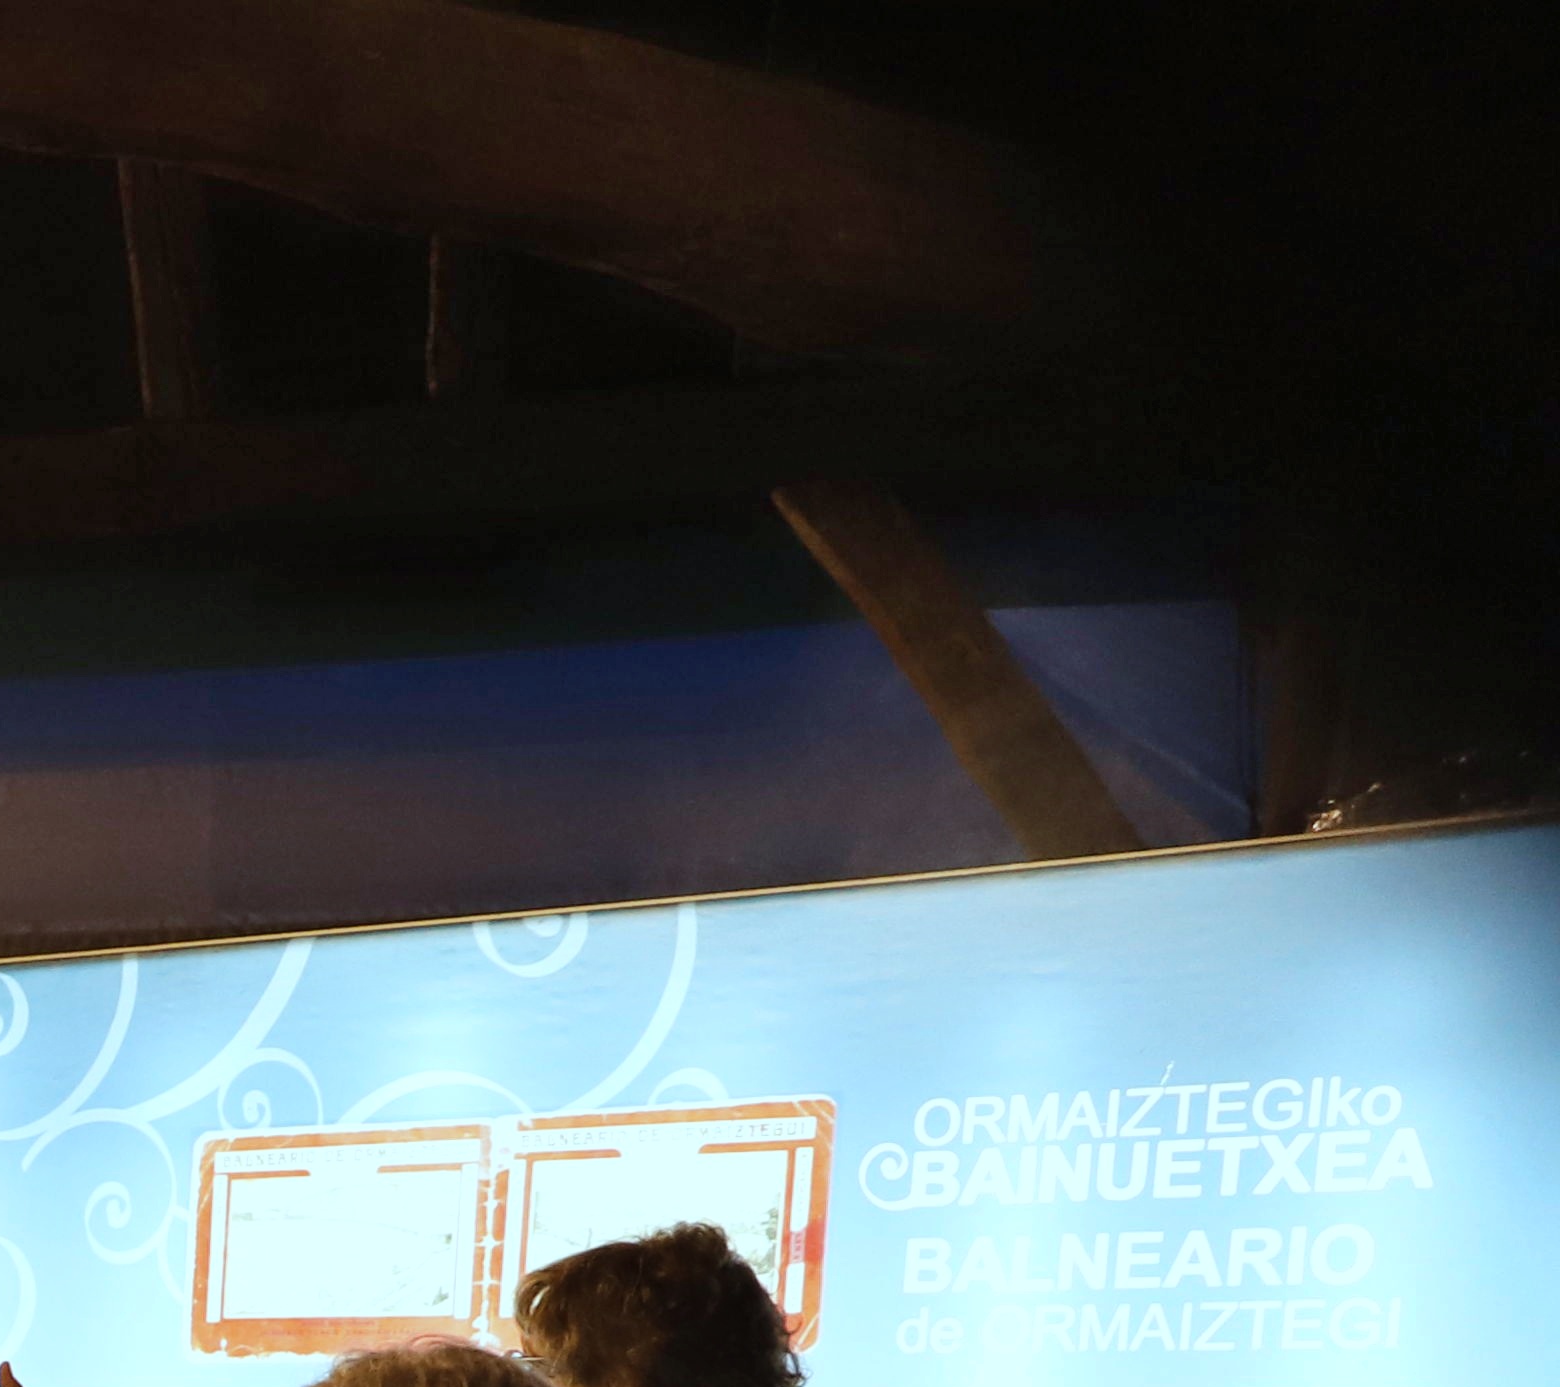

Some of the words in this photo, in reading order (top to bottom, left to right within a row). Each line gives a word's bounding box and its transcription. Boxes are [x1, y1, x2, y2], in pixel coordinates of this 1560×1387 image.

[914, 1075, 1403, 1147] ORMAIZTEGIko
[906, 1127, 1434, 1209] BAINUETXEA
[903, 1223, 1376, 1294] BALNEARIO
[895, 1308, 963, 1355] de
[980, 1297, 1402, 1353] ORMAIZTEGI
